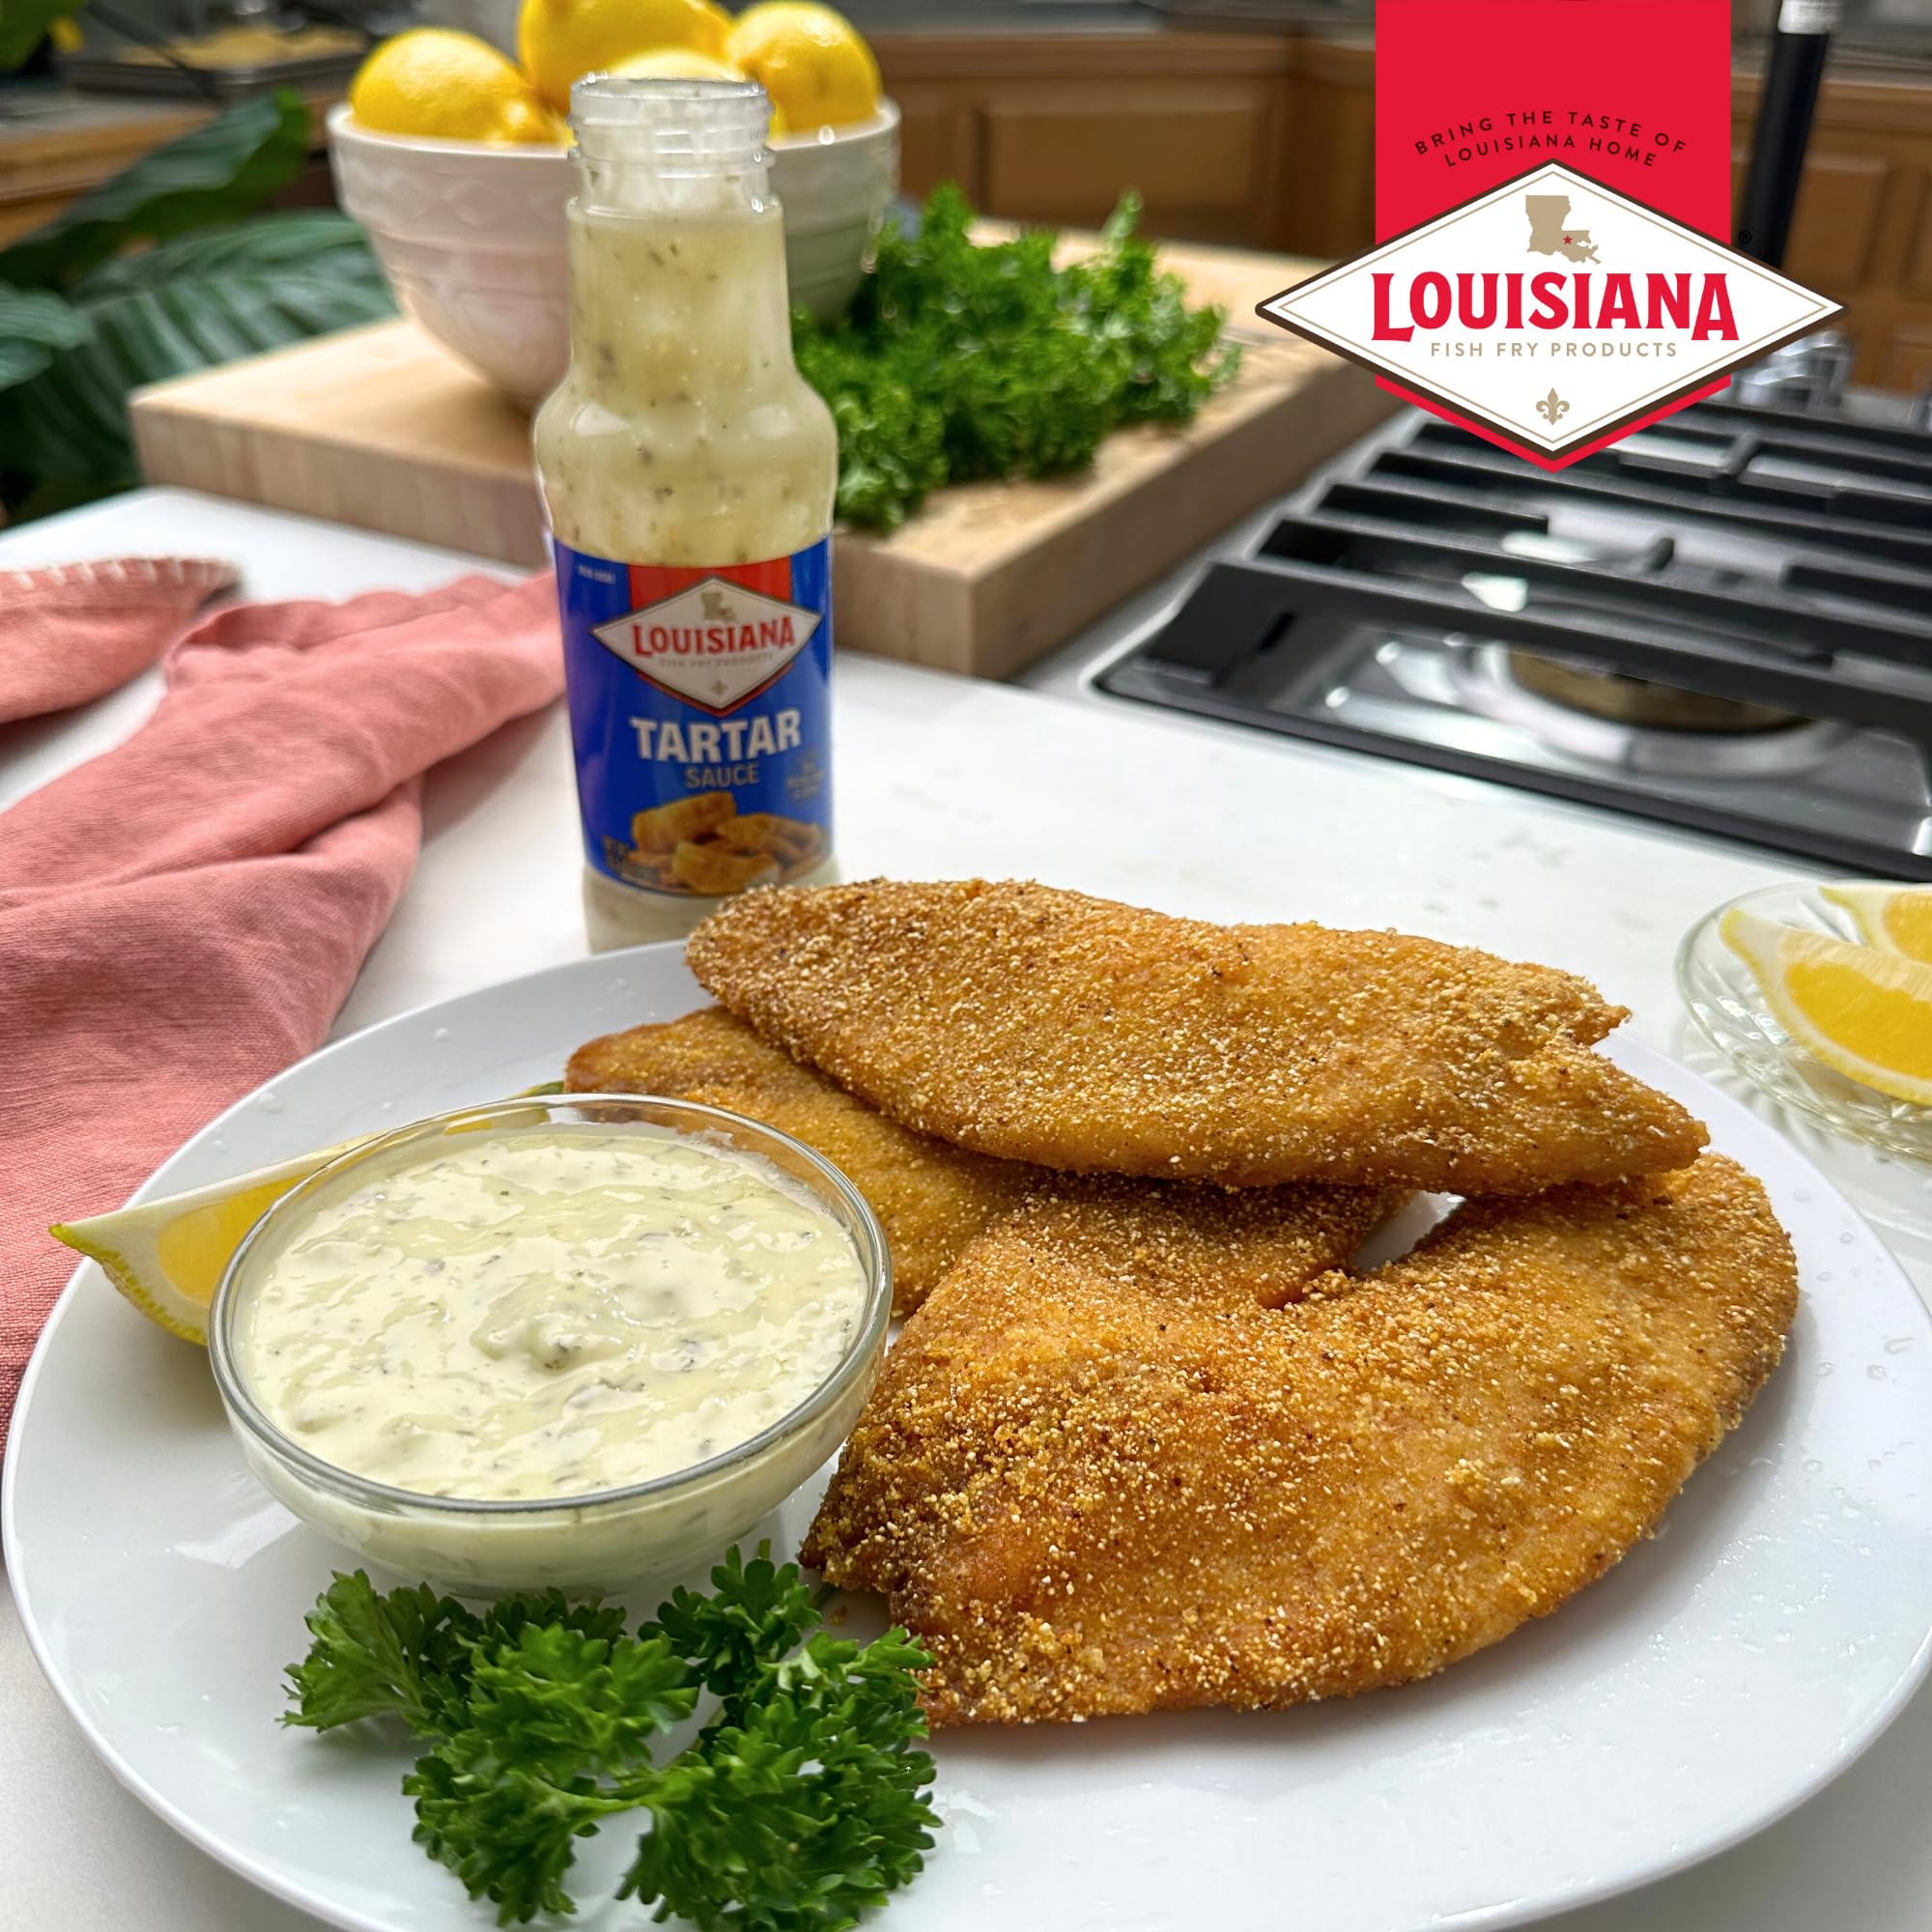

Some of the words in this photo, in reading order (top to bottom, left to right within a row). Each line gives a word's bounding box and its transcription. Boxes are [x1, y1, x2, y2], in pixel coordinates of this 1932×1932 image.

[633, 613, 796, 658] LOUISIANA
[630, 708, 802, 763] TARTAR
[686, 763, 760, 789] SAUCE
